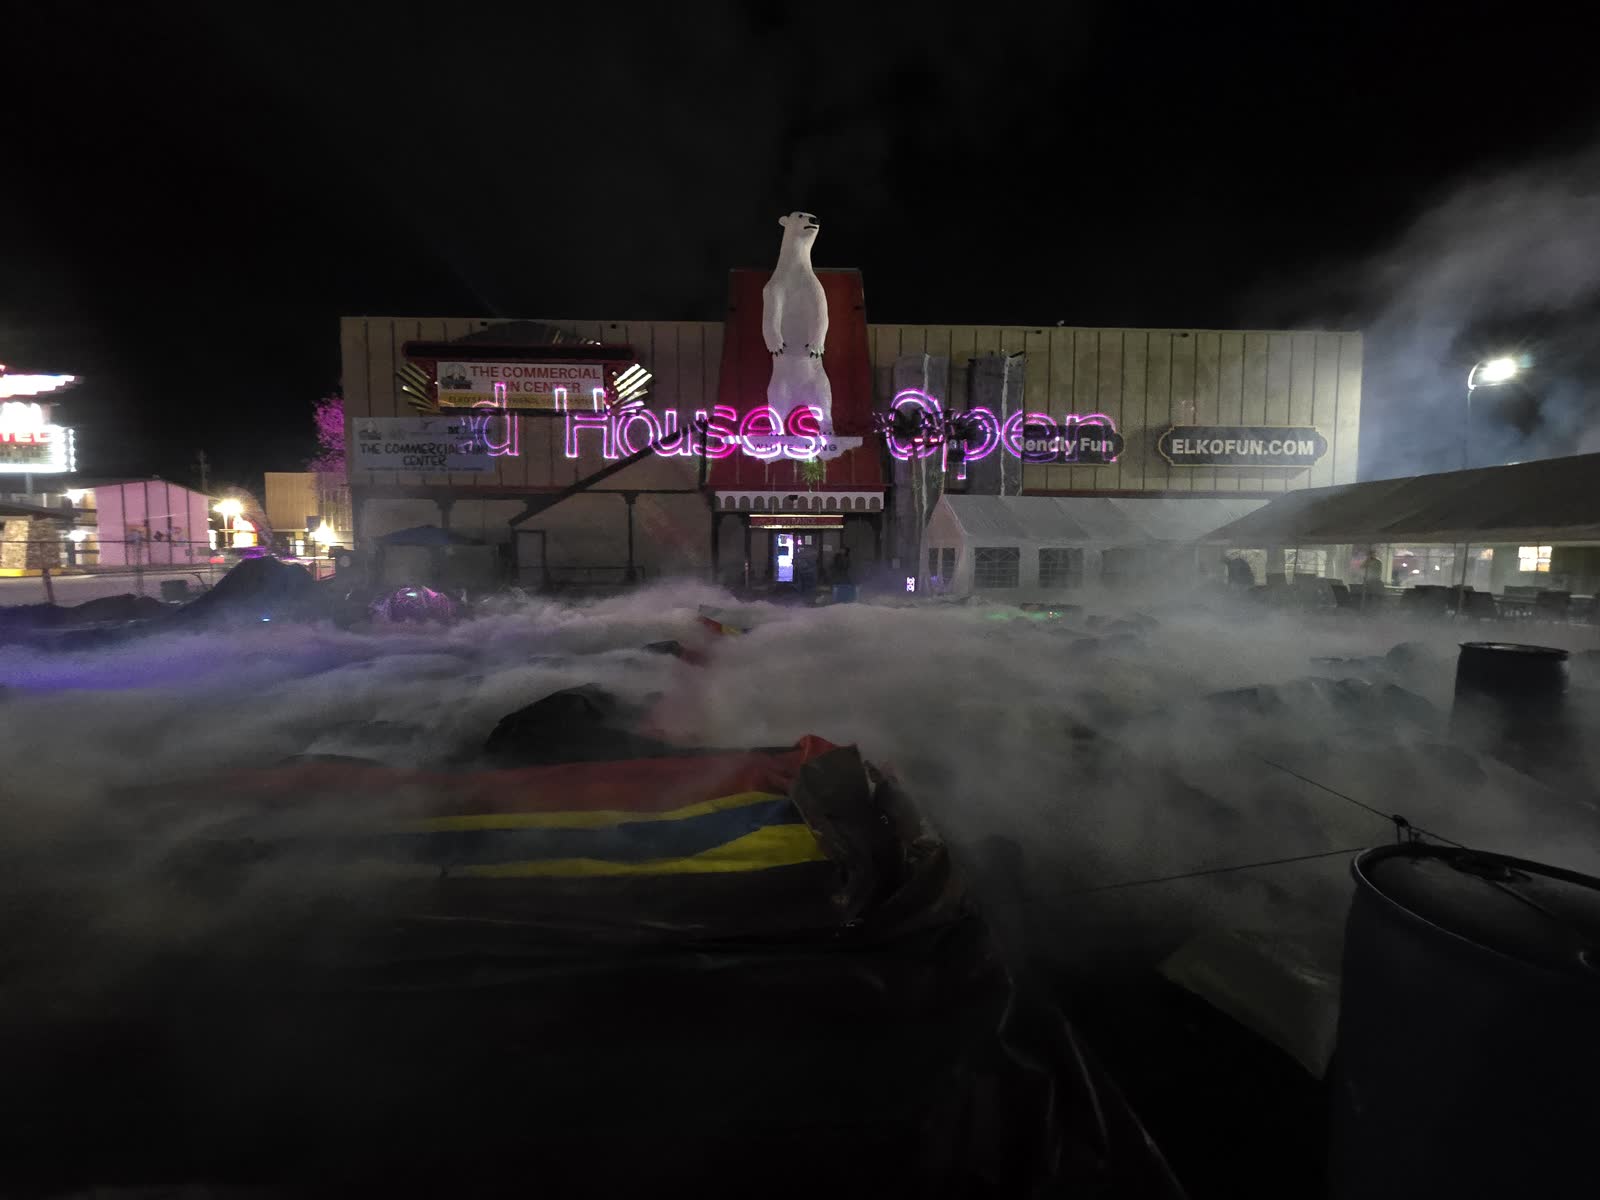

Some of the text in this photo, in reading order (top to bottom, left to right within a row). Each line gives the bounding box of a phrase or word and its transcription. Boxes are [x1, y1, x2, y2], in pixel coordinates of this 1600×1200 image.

[470, 365, 601, 380] THE COMMERCIAL
[523, 381, 582, 394] CENTER
[554, 387, 828, 461] Houses
[359, 443, 381, 455] THE
[1080, 437, 1114, 452] Fun
[1171, 437, 1315, 456] ELKOFUN.COM
[402, 455, 447, 467] CENTER
